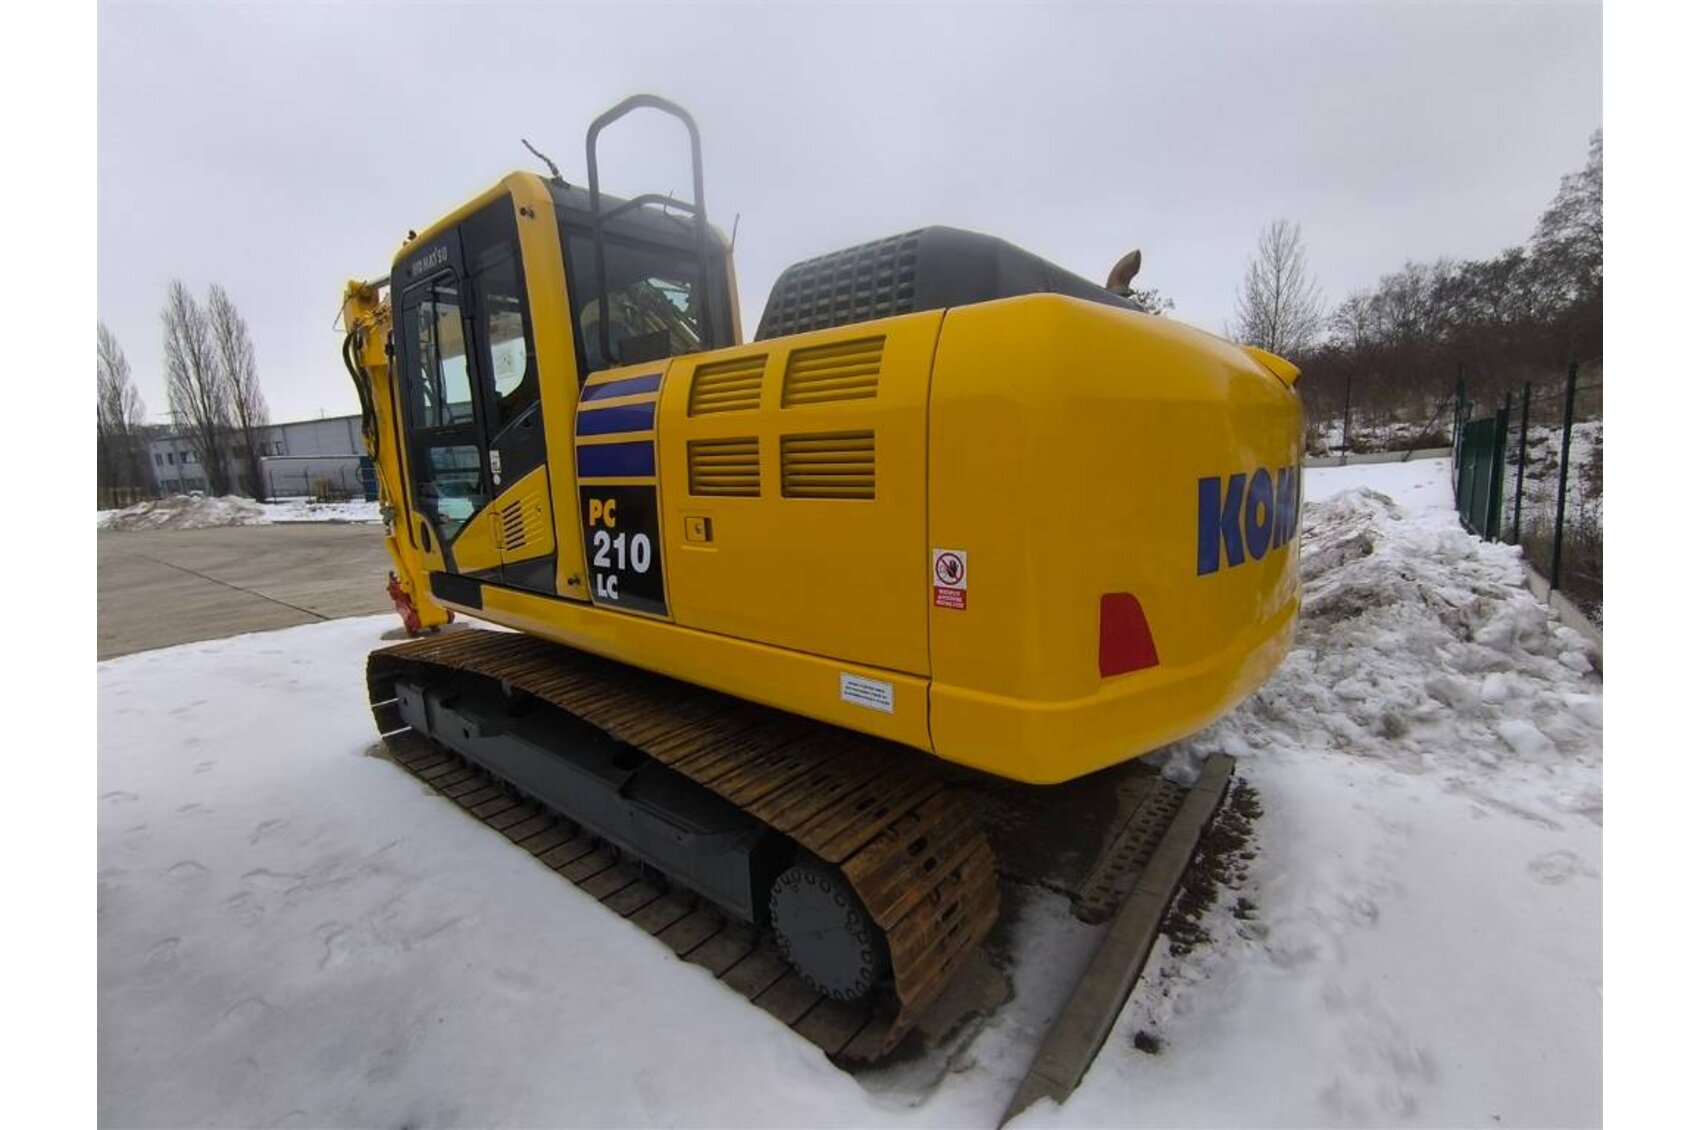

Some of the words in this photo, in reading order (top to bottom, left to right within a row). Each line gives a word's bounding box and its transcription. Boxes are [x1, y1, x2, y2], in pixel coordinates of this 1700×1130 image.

[589, 499, 616, 528] PC
[593, 530, 651, 573] 210
[596, 573, 618, 599] LC
